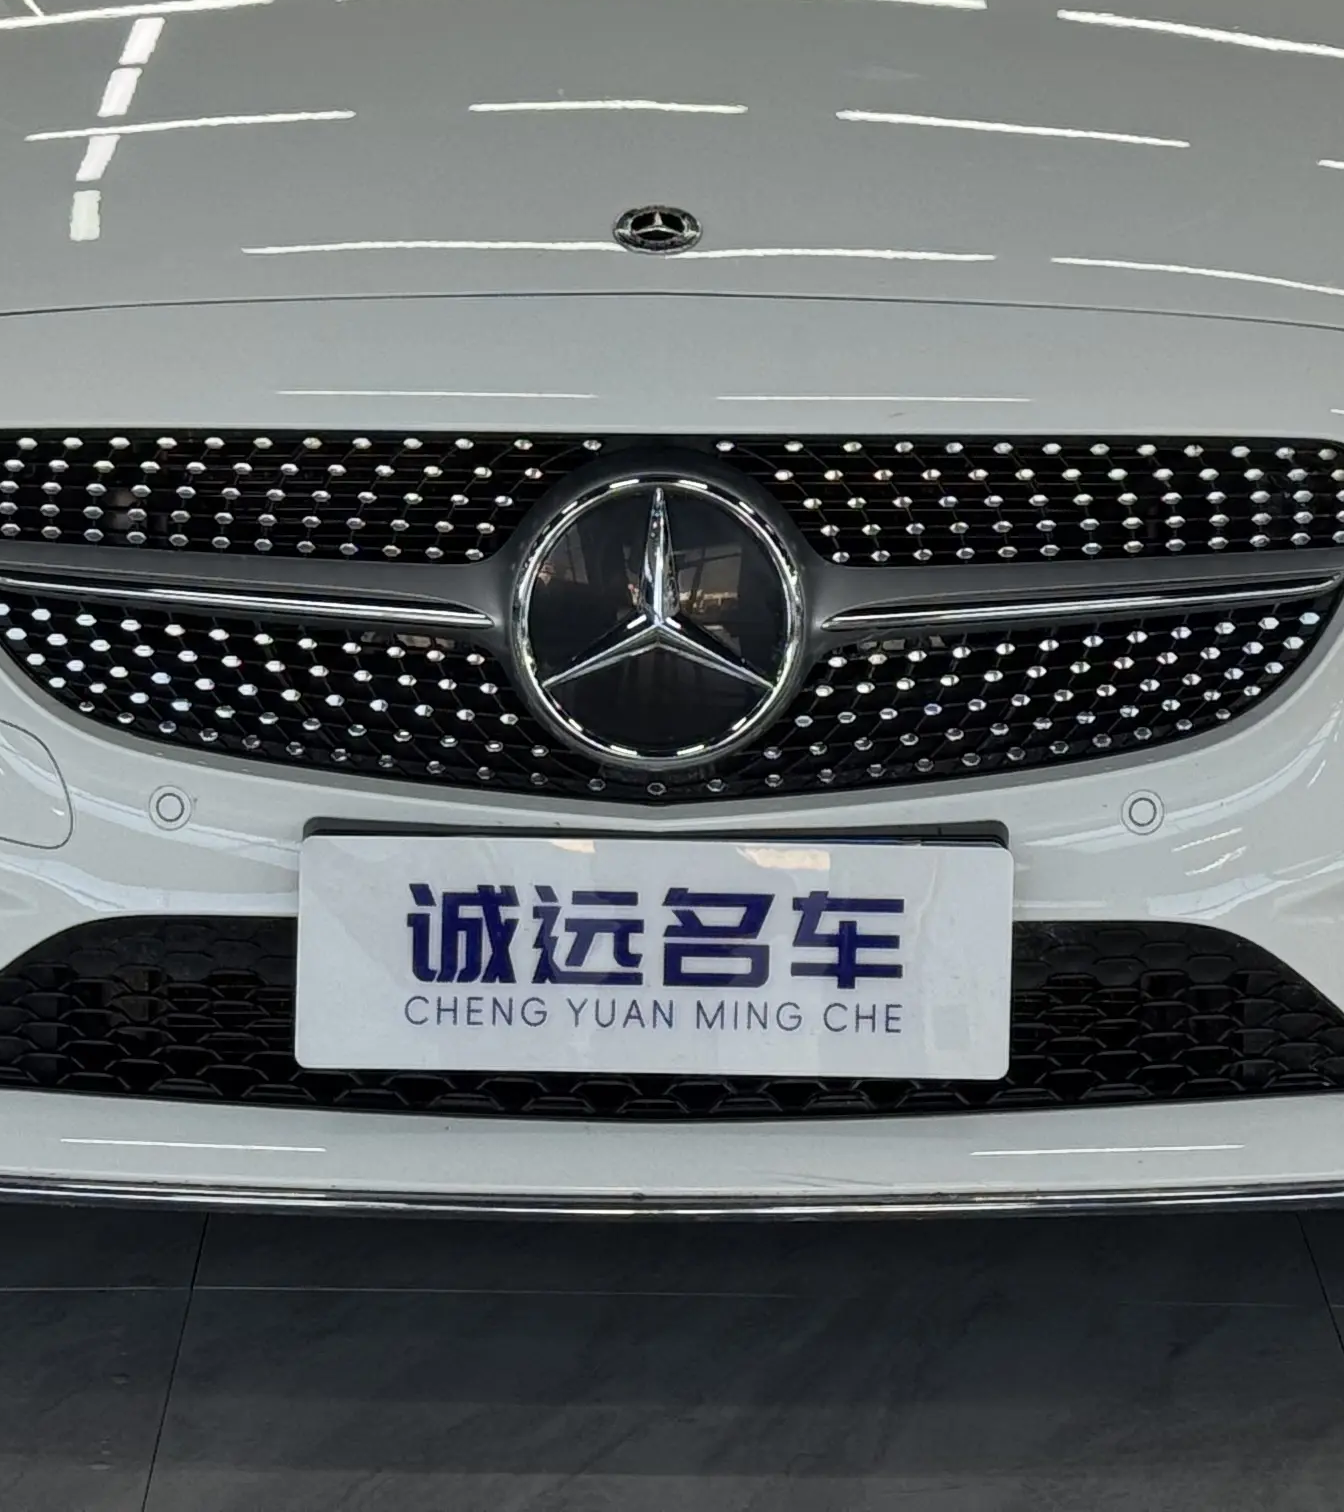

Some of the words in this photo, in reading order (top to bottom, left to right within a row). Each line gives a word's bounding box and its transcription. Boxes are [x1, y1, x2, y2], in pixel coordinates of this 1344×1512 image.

[406, 882, 905, 990] 诚远名车
[403, 995, 549, 1029] CHENG
[566, 997, 675, 1030] YUAN
[695, 999, 804, 1033] MING
[822, 1001, 904, 1034] CHE
